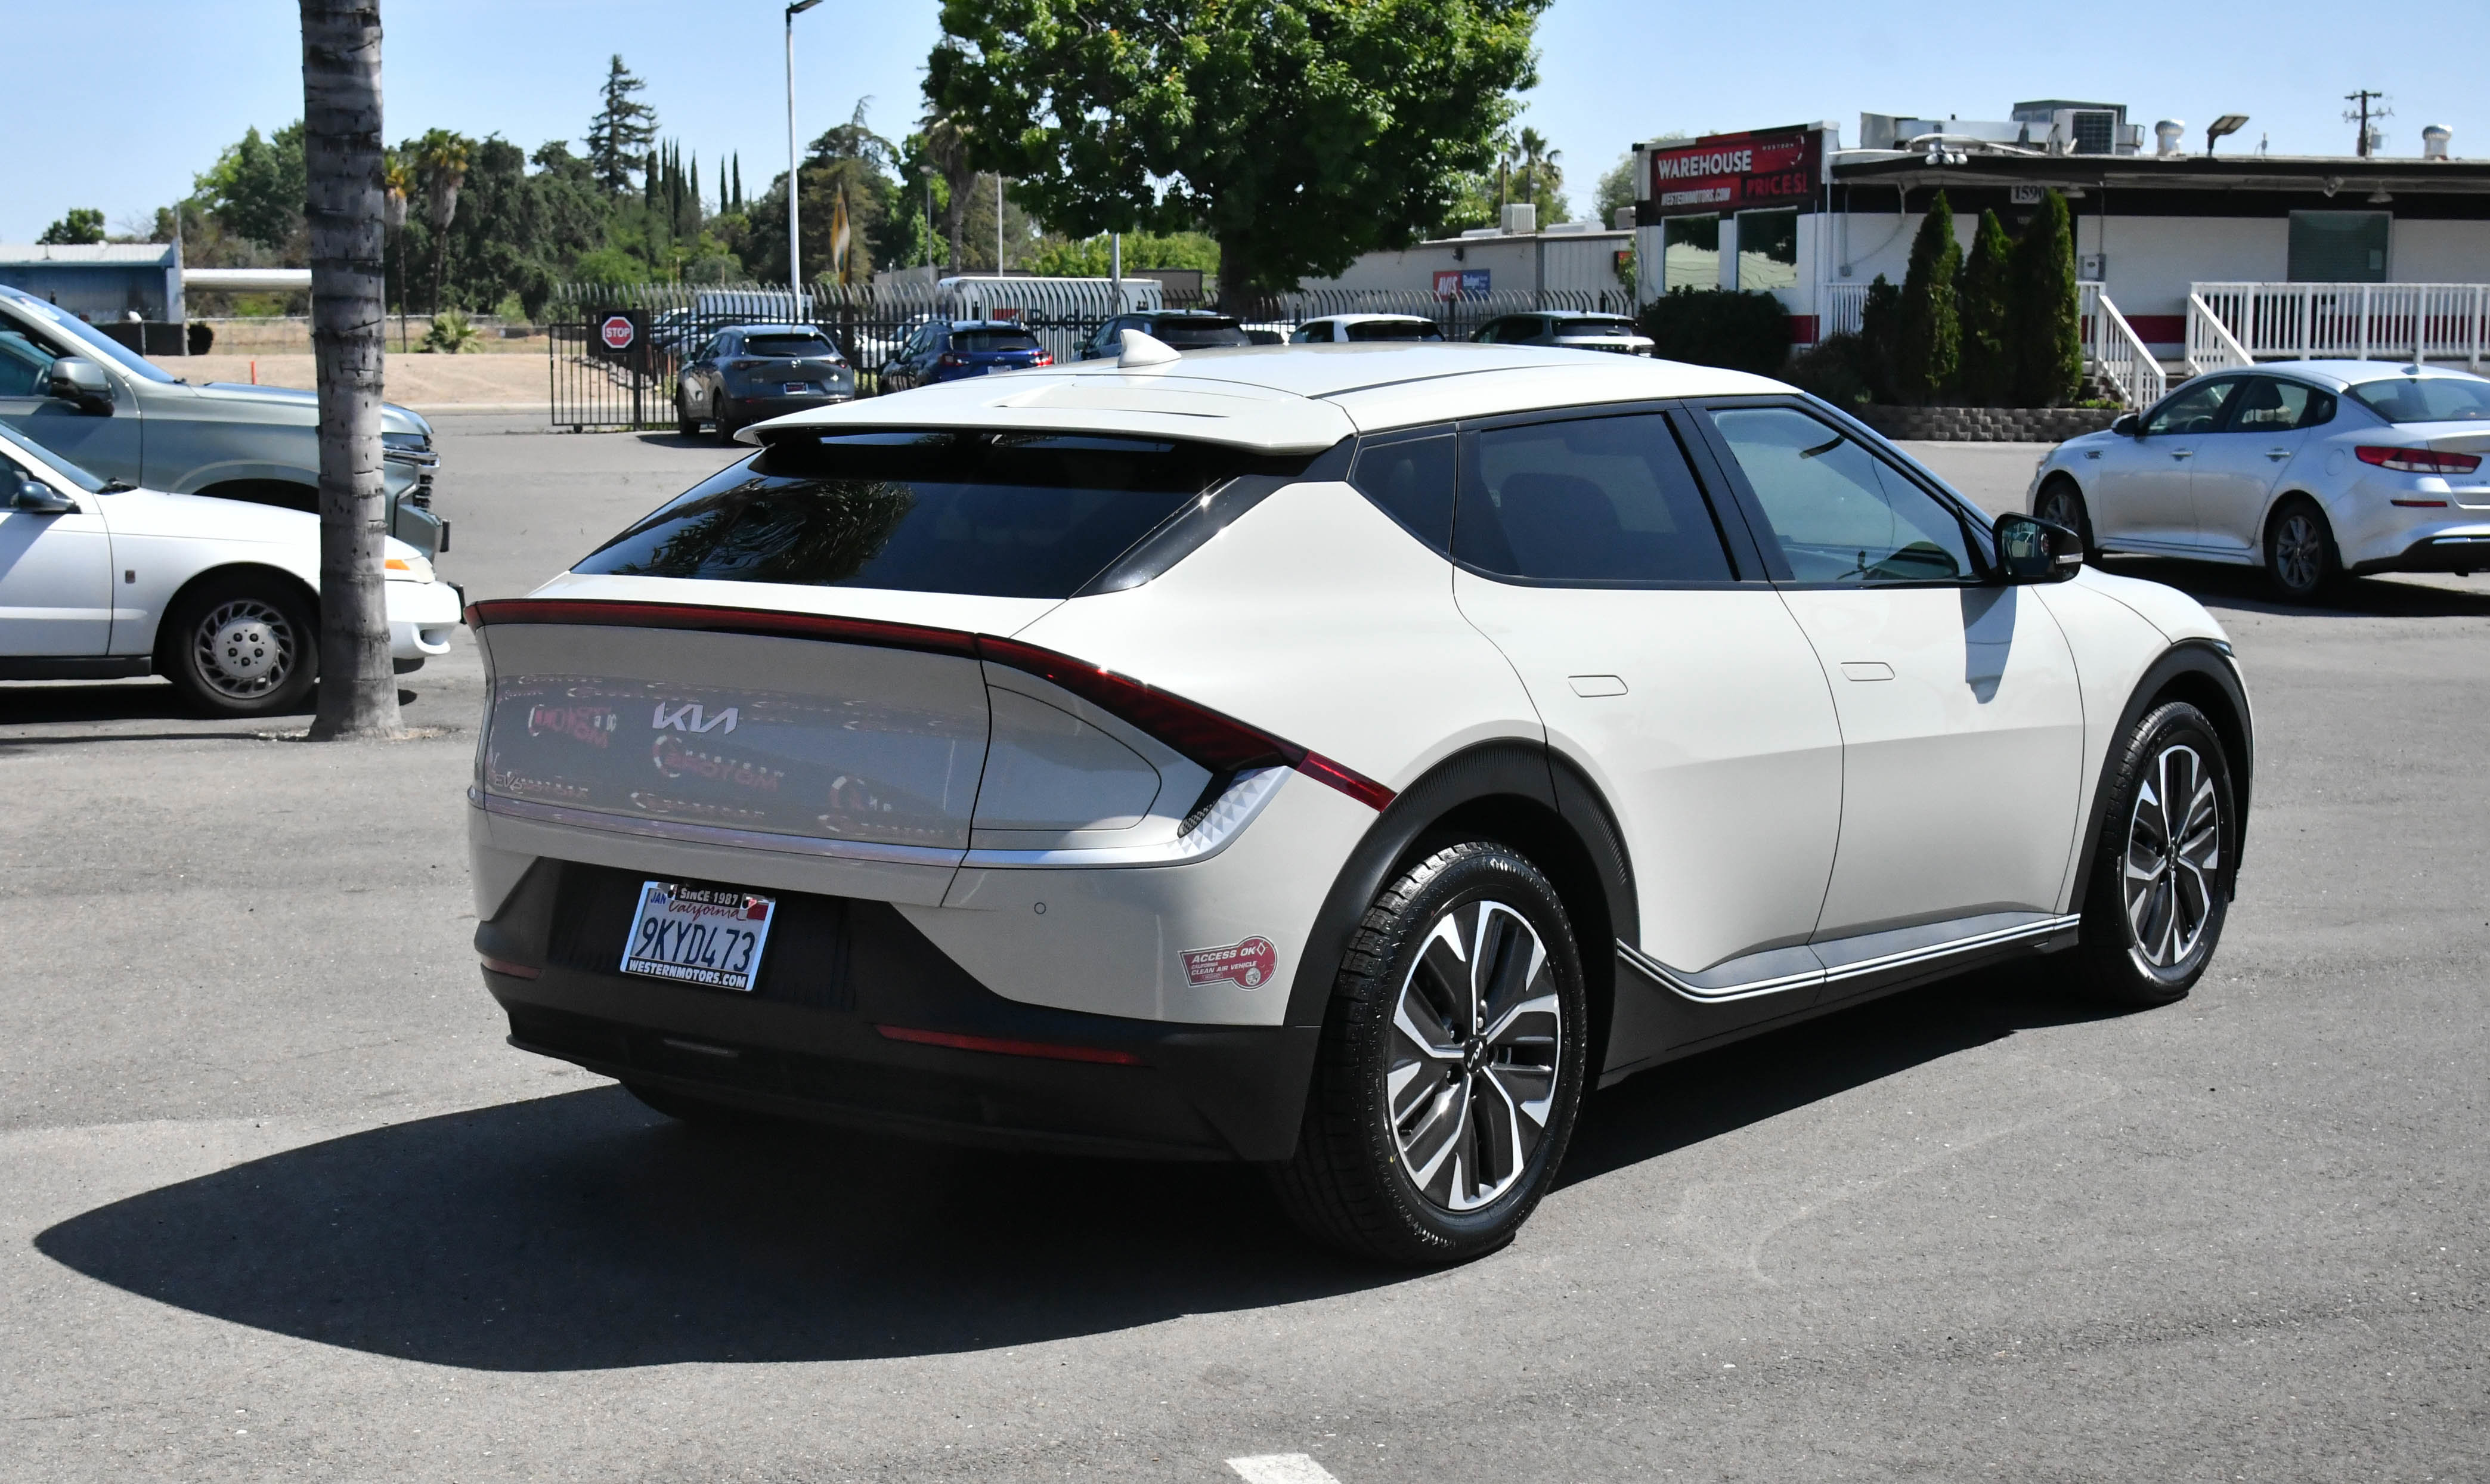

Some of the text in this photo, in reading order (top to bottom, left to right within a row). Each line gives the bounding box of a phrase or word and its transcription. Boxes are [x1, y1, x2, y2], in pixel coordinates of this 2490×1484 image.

[1658, 150, 1752, 180] WAREHOUSE
[1746, 172, 1808, 197] PRICES!
[1438, 276, 1458, 296] AVIS
[606, 327, 630, 338] STOP
[652, 701, 739, 735] KIA
[650, 891, 667, 905] JAN
[679, 887, 739, 906] SINCE 1987
[668, 900, 747, 922] California
[635, 916, 756, 972] 9KYD473
[1191, 946, 1257, 963] ACCESS OK
[628, 959, 747, 989] WESTERNMOTORS.COM
[1191, 968, 1215, 976] CLEAN
[1230, 961, 1258, 971] VEHICLE
